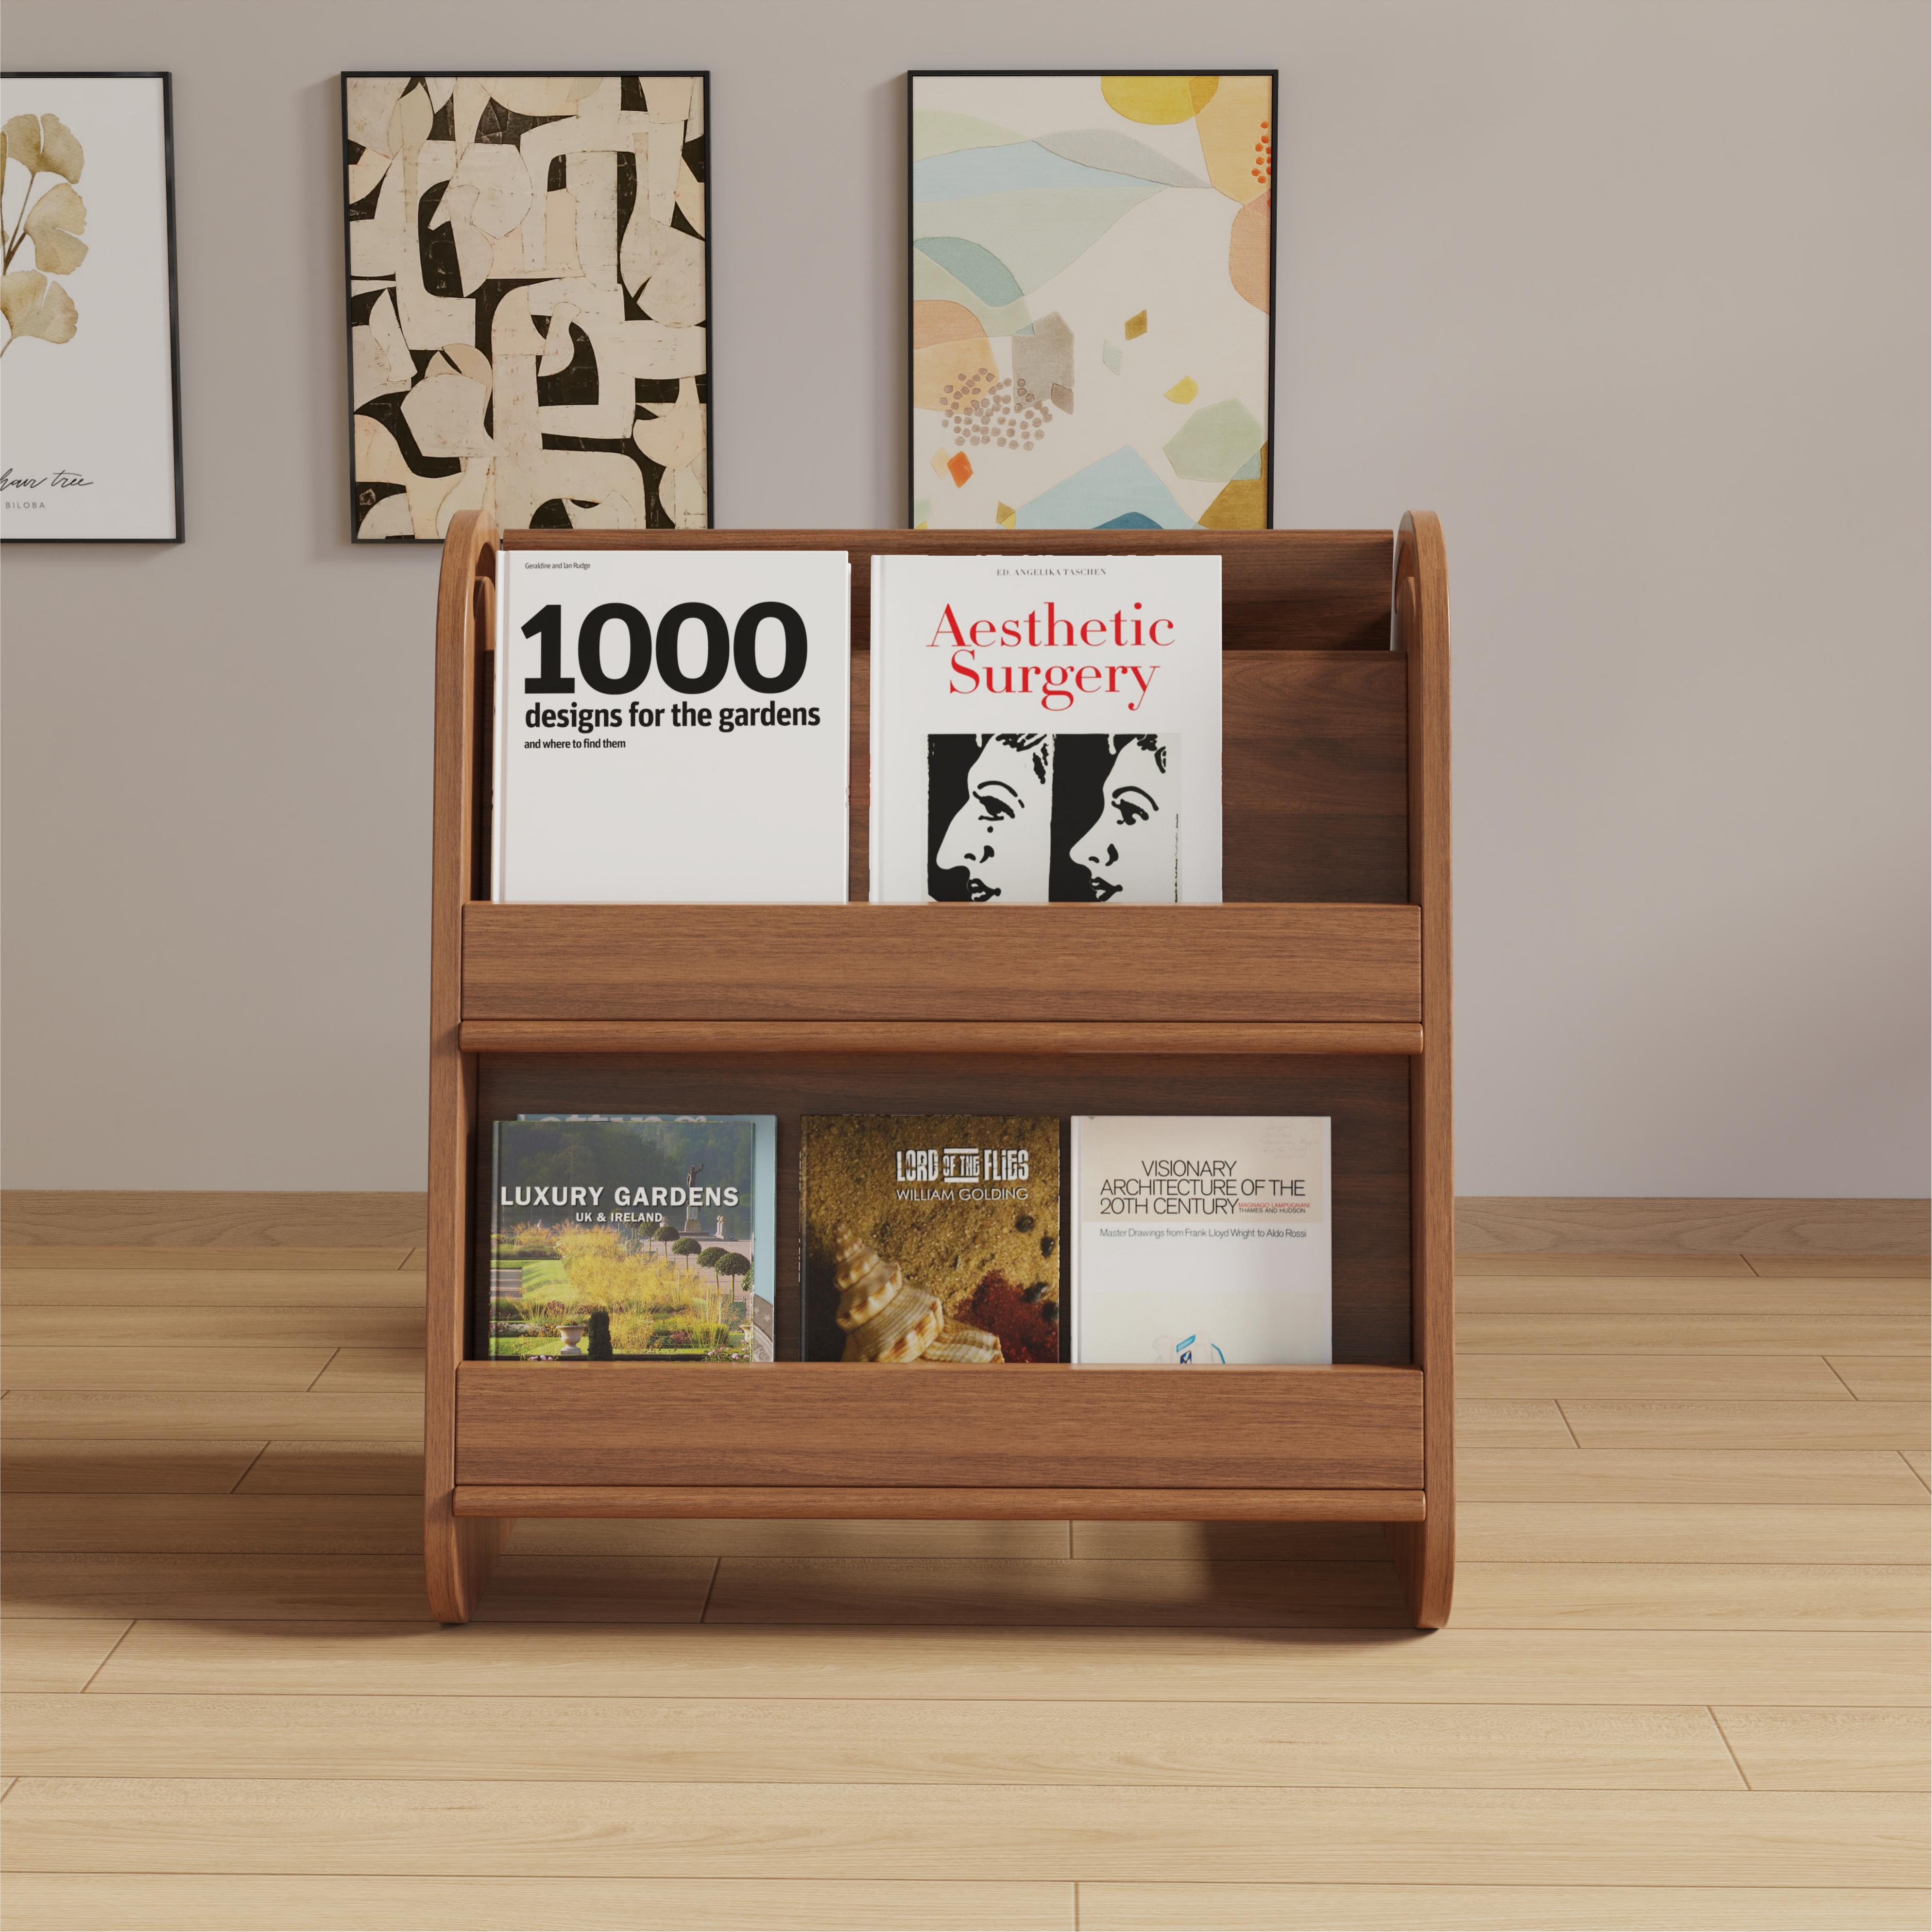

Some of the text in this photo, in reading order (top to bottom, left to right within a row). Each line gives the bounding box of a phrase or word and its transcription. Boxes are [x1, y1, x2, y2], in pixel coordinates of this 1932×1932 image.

[51, 469, 93, 488] tree
[573, 562, 591, 570] Rudge
[925, 602, 1176, 647] Aesthetic
[521, 601, 807, 695] 1000
[949, 649, 1161, 711] Surgery
[525, 701, 821, 734] designs for the gardens
[524, 738, 626, 749] and where to find them
[897, 1149, 939, 1181] LORD
[942, 1155, 956, 1177] OF
[959, 1155, 980, 1176] THE
[1142, 1160, 1237, 1177] VISIONARY
[501, 1186, 739, 1206] LUXURY GARDENS
[896, 1188, 1029, 1201] WILLIAM GOLDING
[1100, 1179, 1306, 1196] ARCHITECTURE OF THE
[1154, 1197, 1239, 1214] CENTURY
[576, 1213, 663, 1222] UK & IRELAND
[1128, 1229, 1165, 1238] Drawings
[1209, 1229, 1229, 1239] Lloyd
[1231, 1229, 1255, 1239] Wright
[1257, 1229, 1265, 1237] to
[1266, 1229, 1284, 1237] Aldo
[1285, 1229, 1307, 1237] Rossi
